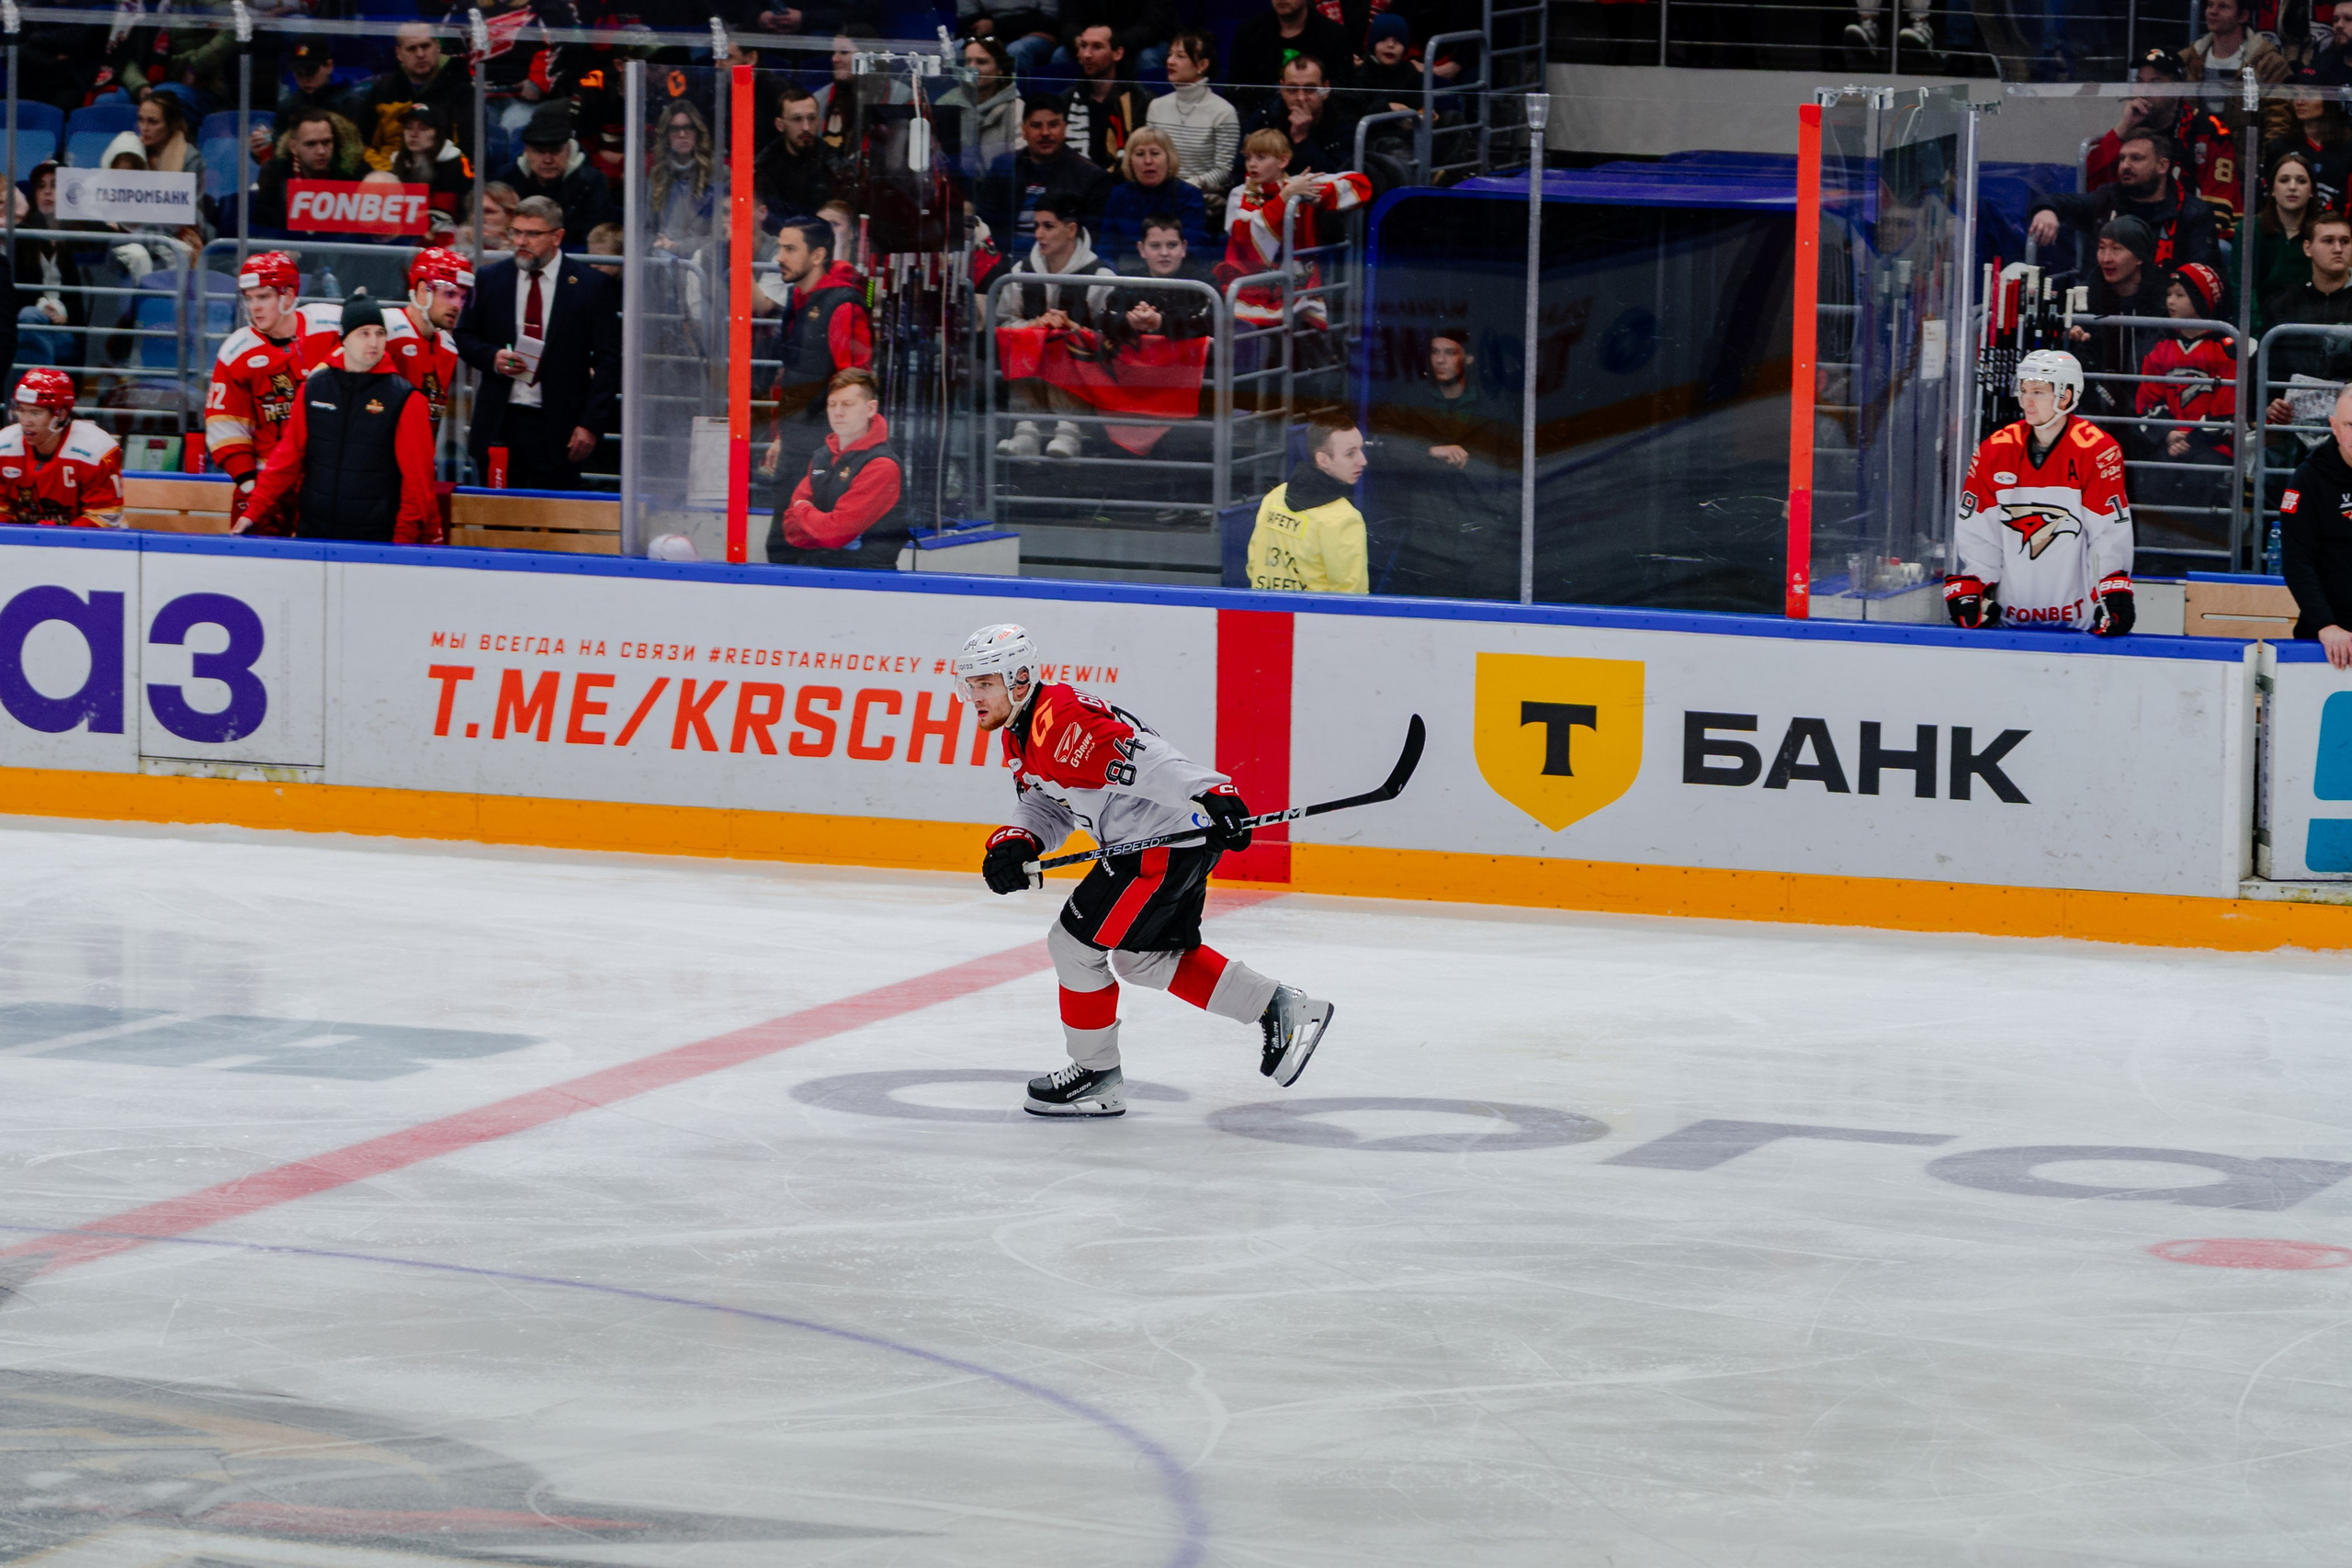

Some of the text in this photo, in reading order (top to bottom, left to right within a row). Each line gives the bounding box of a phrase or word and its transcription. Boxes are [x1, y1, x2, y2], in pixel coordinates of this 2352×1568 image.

[96, 187, 189, 205] ГАЗПРОМБАНК
[290, 191, 427, 223] FONBET
[62, 466, 76, 488] C
[2067, 459, 2079, 480] A
[2005, 598, 2085, 623] FONBET
[431, 632, 466, 649] МЫ
[479, 634, 564, 655] ВСЕГДА
[579, 640, 605, 656] НА
[620, 641, 695, 661] СВЯЗИ
[708, 648, 921, 673] #REDSTARHOCKEY
[1105, 738, 1147, 786] 84
[1520, 700, 2032, 805] Т БАНК
[1084, 838, 1160, 861] JETSPEED
[1066, 1081, 1092, 1100] BAUER
